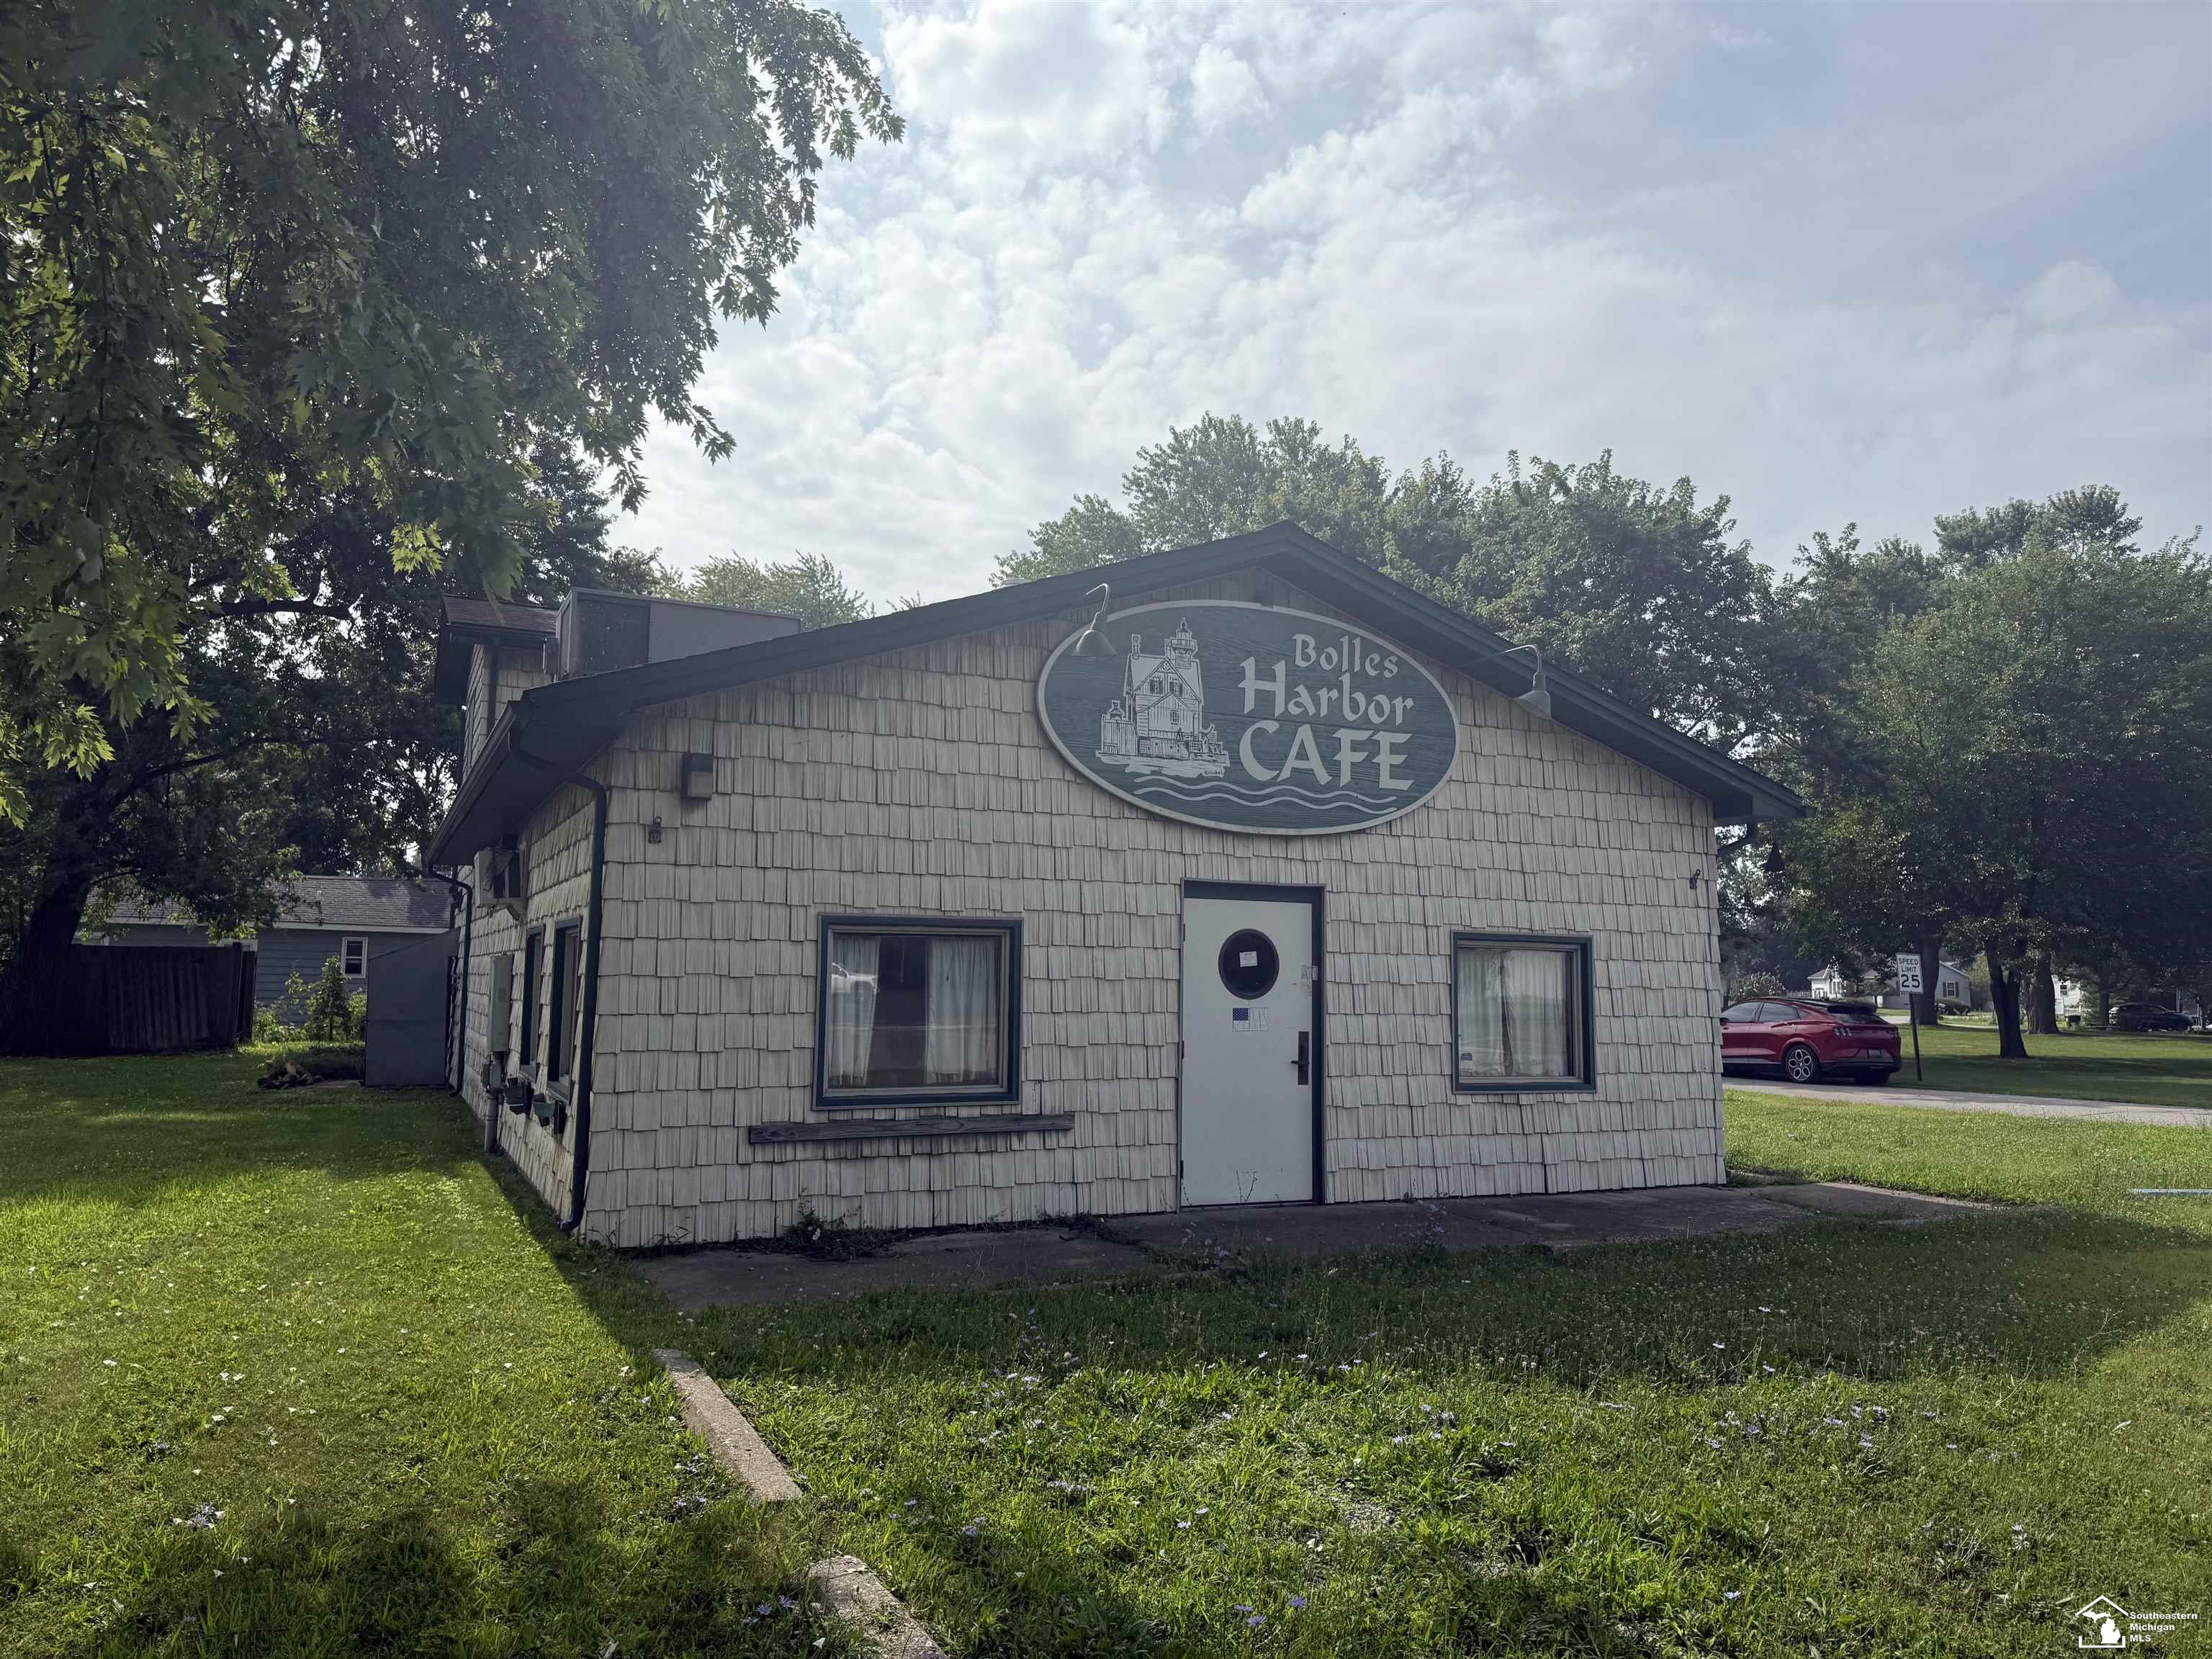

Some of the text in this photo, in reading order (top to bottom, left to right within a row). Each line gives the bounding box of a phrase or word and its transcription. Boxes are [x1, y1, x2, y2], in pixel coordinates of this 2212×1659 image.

[1292, 634, 1398, 678] Bolles
[1237, 657, 1414, 726] Harbor
[1239, 720, 1415, 791] CAFE
[1900, 974, 1920, 989] 25
